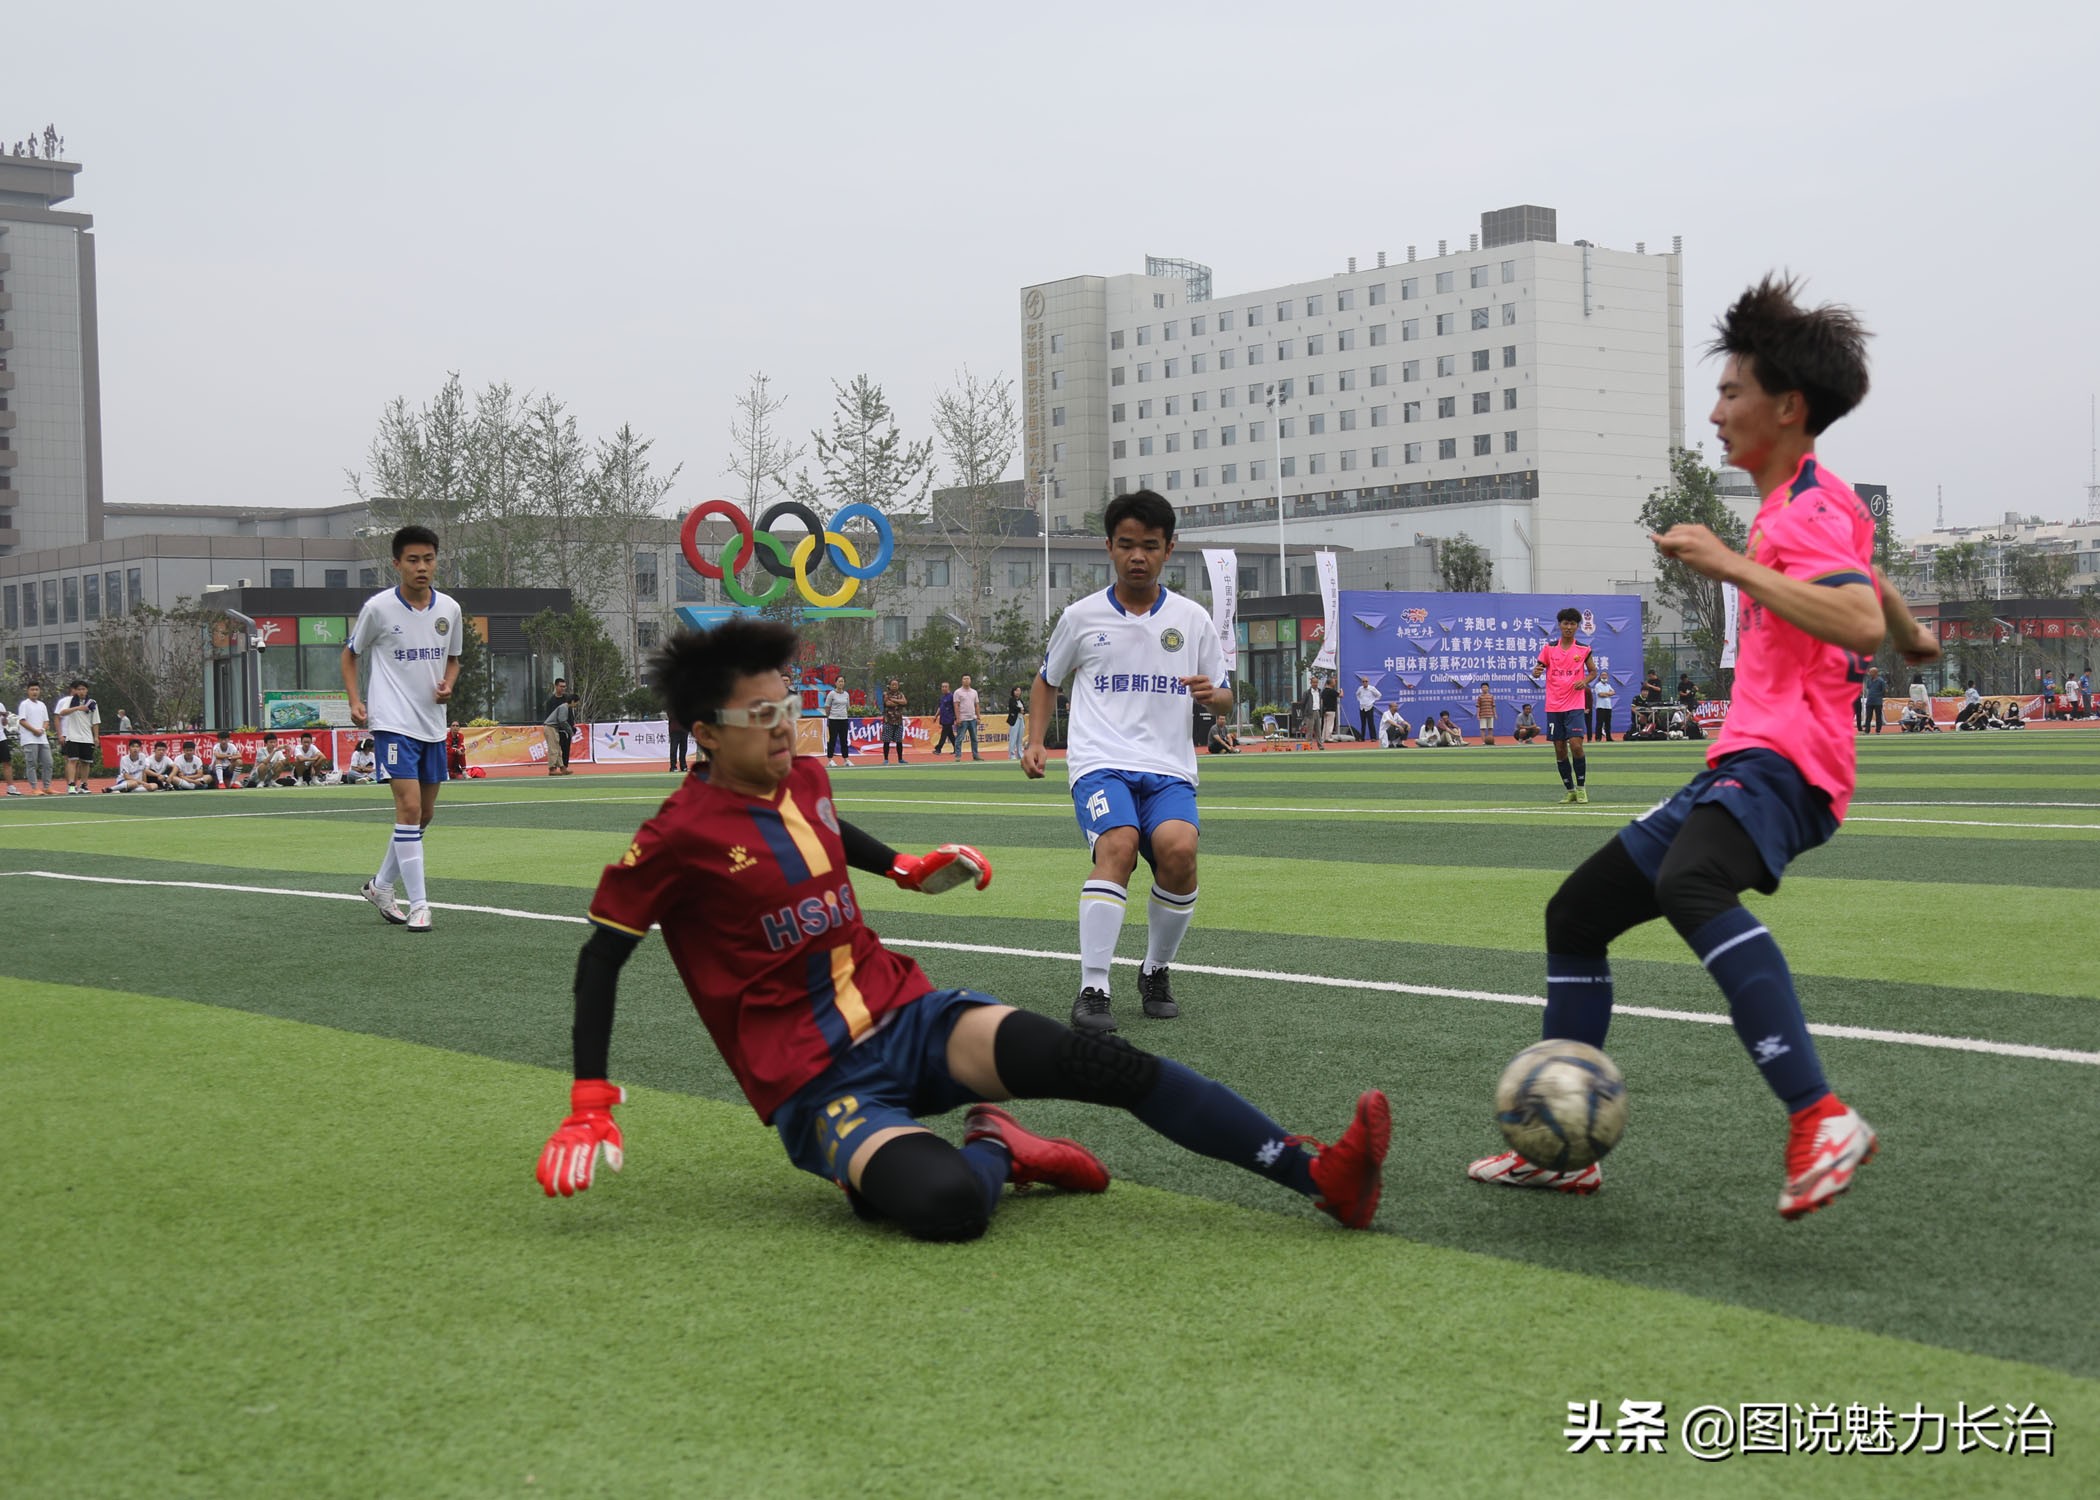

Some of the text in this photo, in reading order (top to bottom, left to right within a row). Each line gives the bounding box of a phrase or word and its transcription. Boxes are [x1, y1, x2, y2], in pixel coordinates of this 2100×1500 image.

[1491, 673, 1516, 681] themed
[388, 743, 398, 765] 6
[1086, 789, 1111, 822] 15
